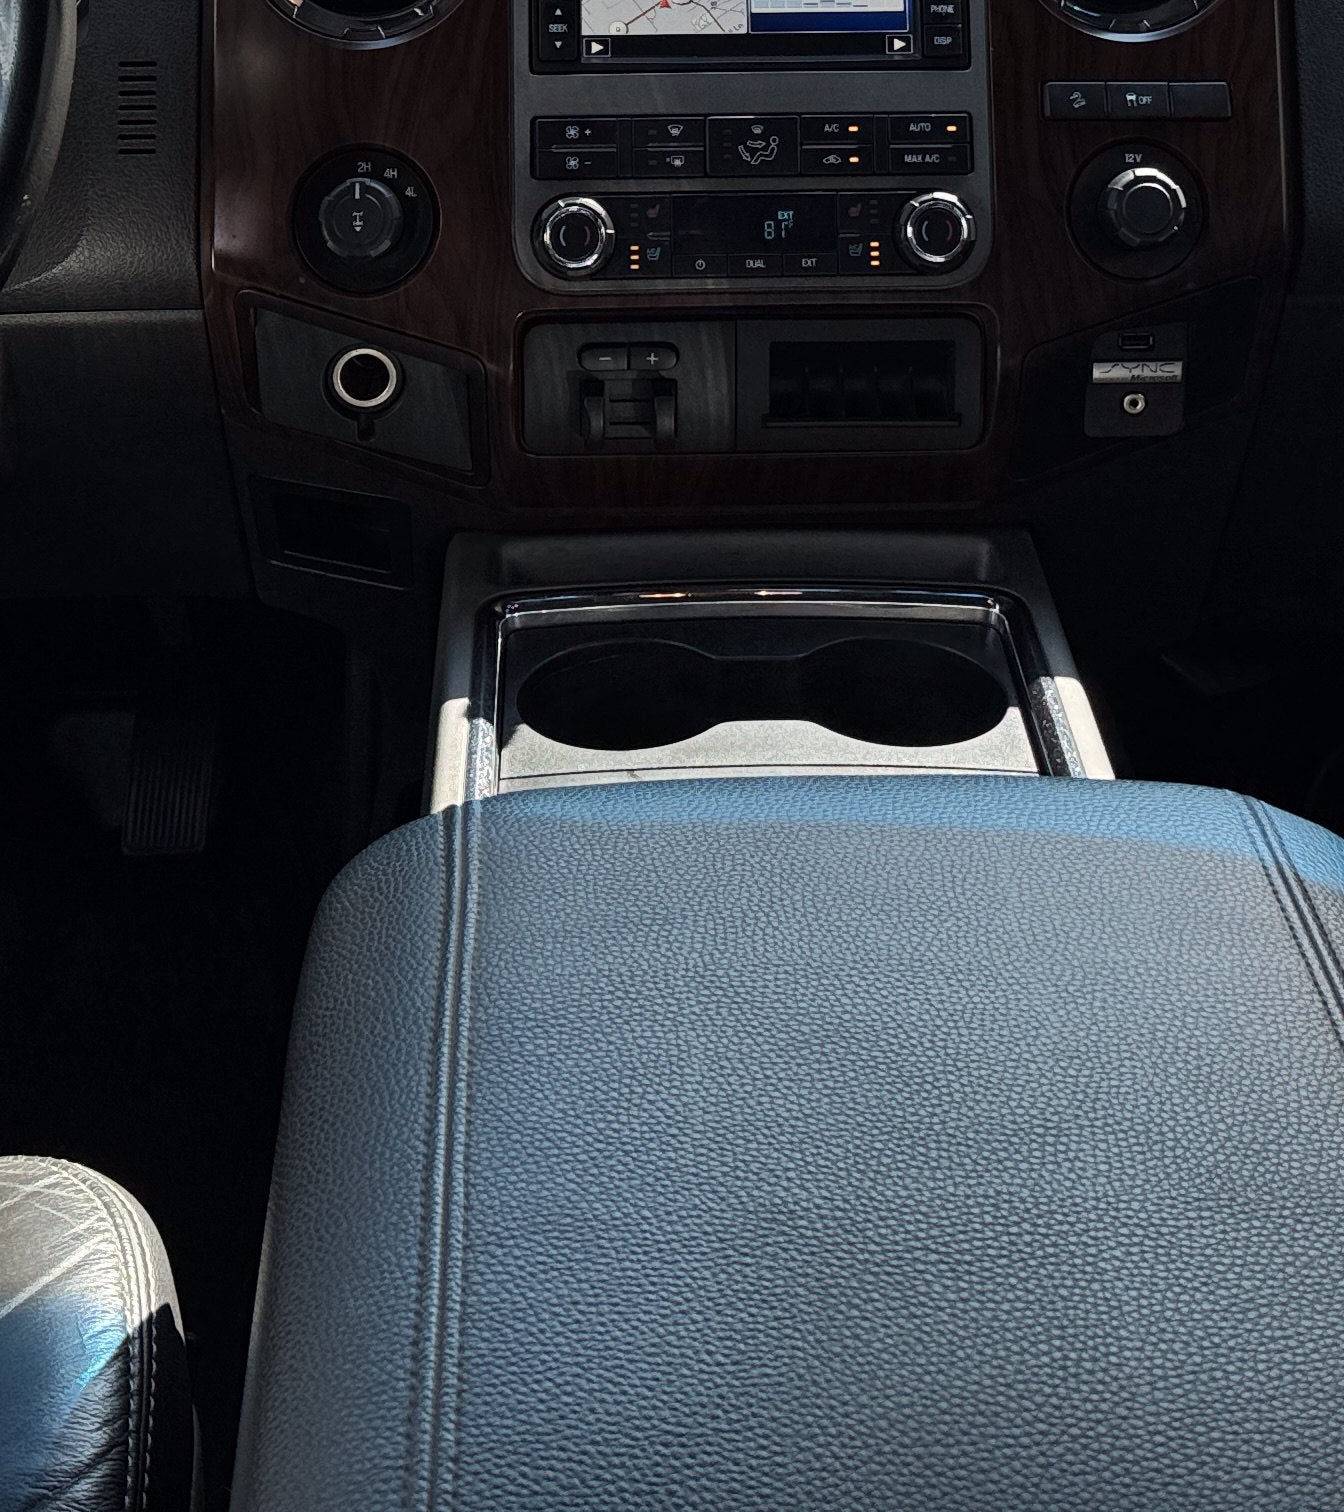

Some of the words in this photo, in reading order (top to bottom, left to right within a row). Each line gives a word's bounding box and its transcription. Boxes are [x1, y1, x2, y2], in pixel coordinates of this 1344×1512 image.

[930, 3, 955, 15] PHONE
[547, 22, 569, 34] SEEK
[933, 35, 953, 45] DISP
[1138, 95, 1153, 105] OFF
[823, 123, 840, 133] A/C
[908, 122, 932, 132] AUTO
[904, 154, 924, 164] MAX
[924, 154, 941, 163] A/C
[356, 161, 372, 173] 2H
[383, 168, 398, 179] 4H
[404, 186, 418, 198] 4L
[777, 210, 795, 220] EXT
[745, 259, 767, 269] DUAL
[801, 258, 818, 268] EXT
[1098, 362, 1176, 374] SYNC
